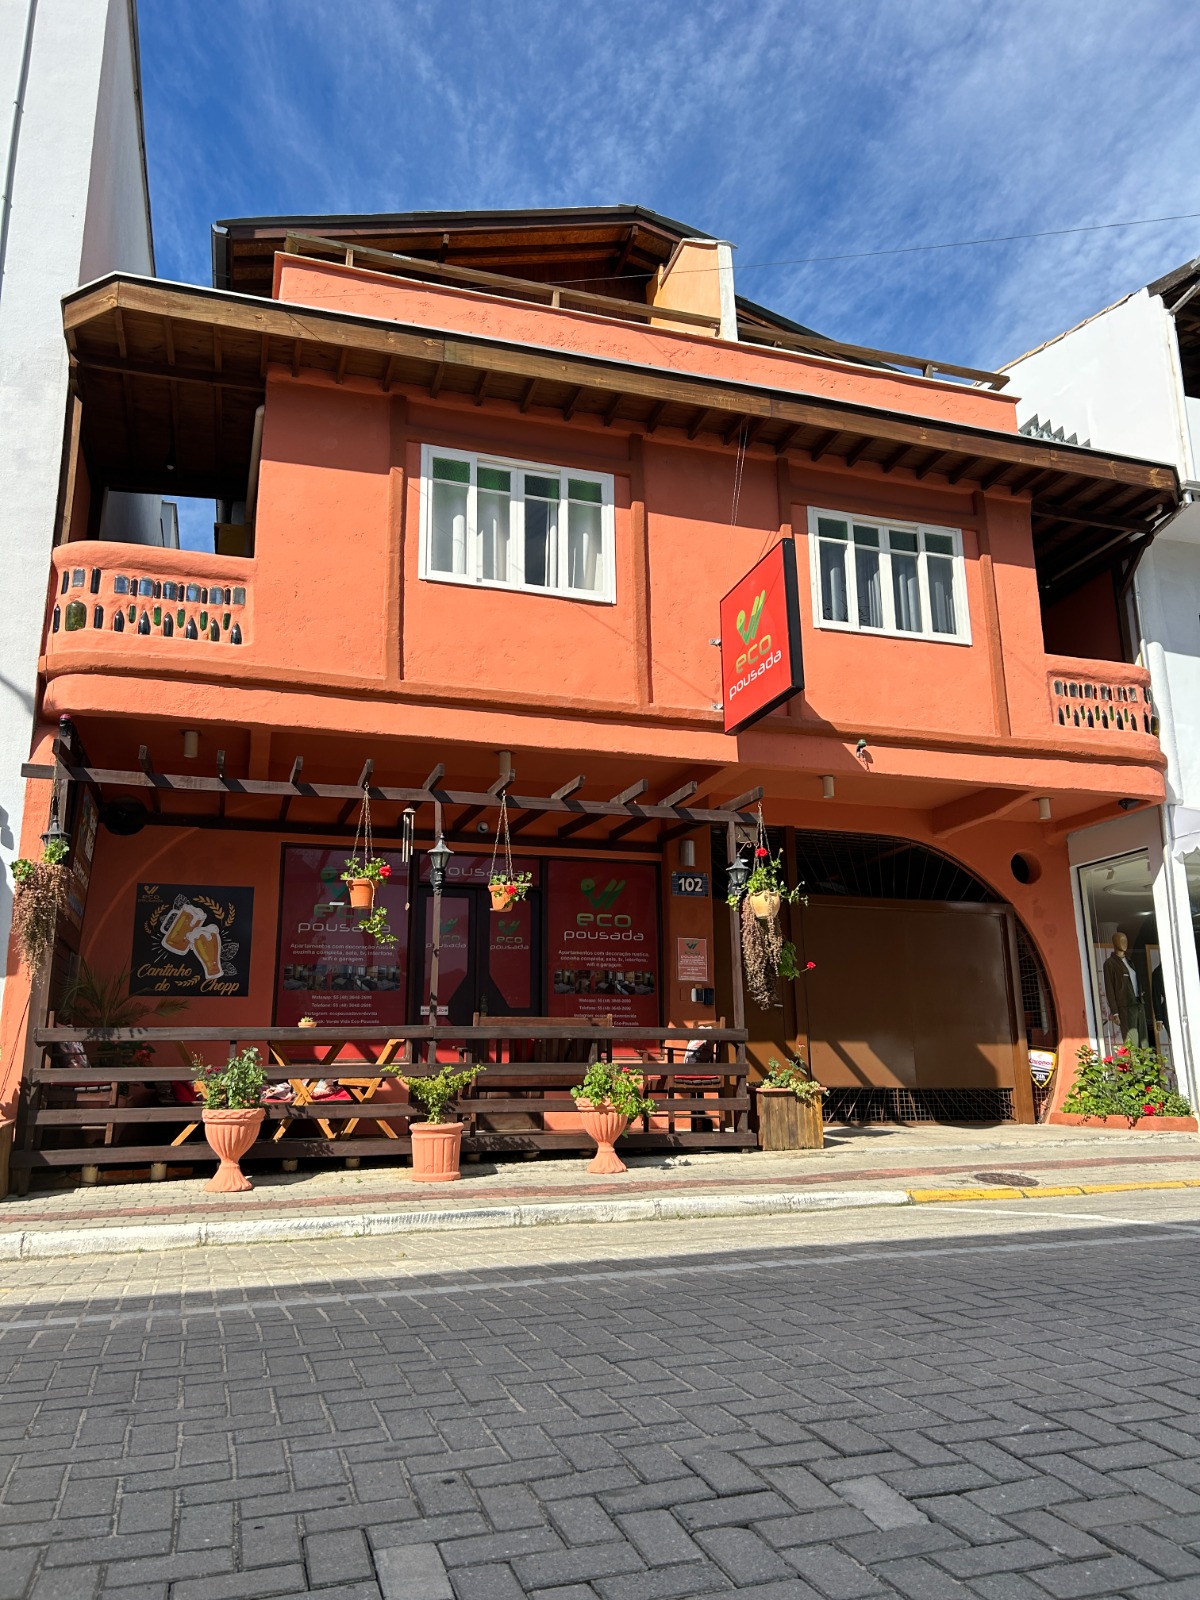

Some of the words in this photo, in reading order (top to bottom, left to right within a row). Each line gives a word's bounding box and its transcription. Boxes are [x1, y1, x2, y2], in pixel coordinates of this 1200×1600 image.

[735, 634, 772, 674] eco
[729, 649, 782, 701] pousada
[678, 877, 703, 892] 102
[576, 912, 632, 927] eco
[496, 936, 523, 944] eco
[563, 929, 645, 941] pousada
[137, 962, 193, 978] Cantinho
[154, 978, 171, 992] do
[200, 979, 240, 996] Chopp
